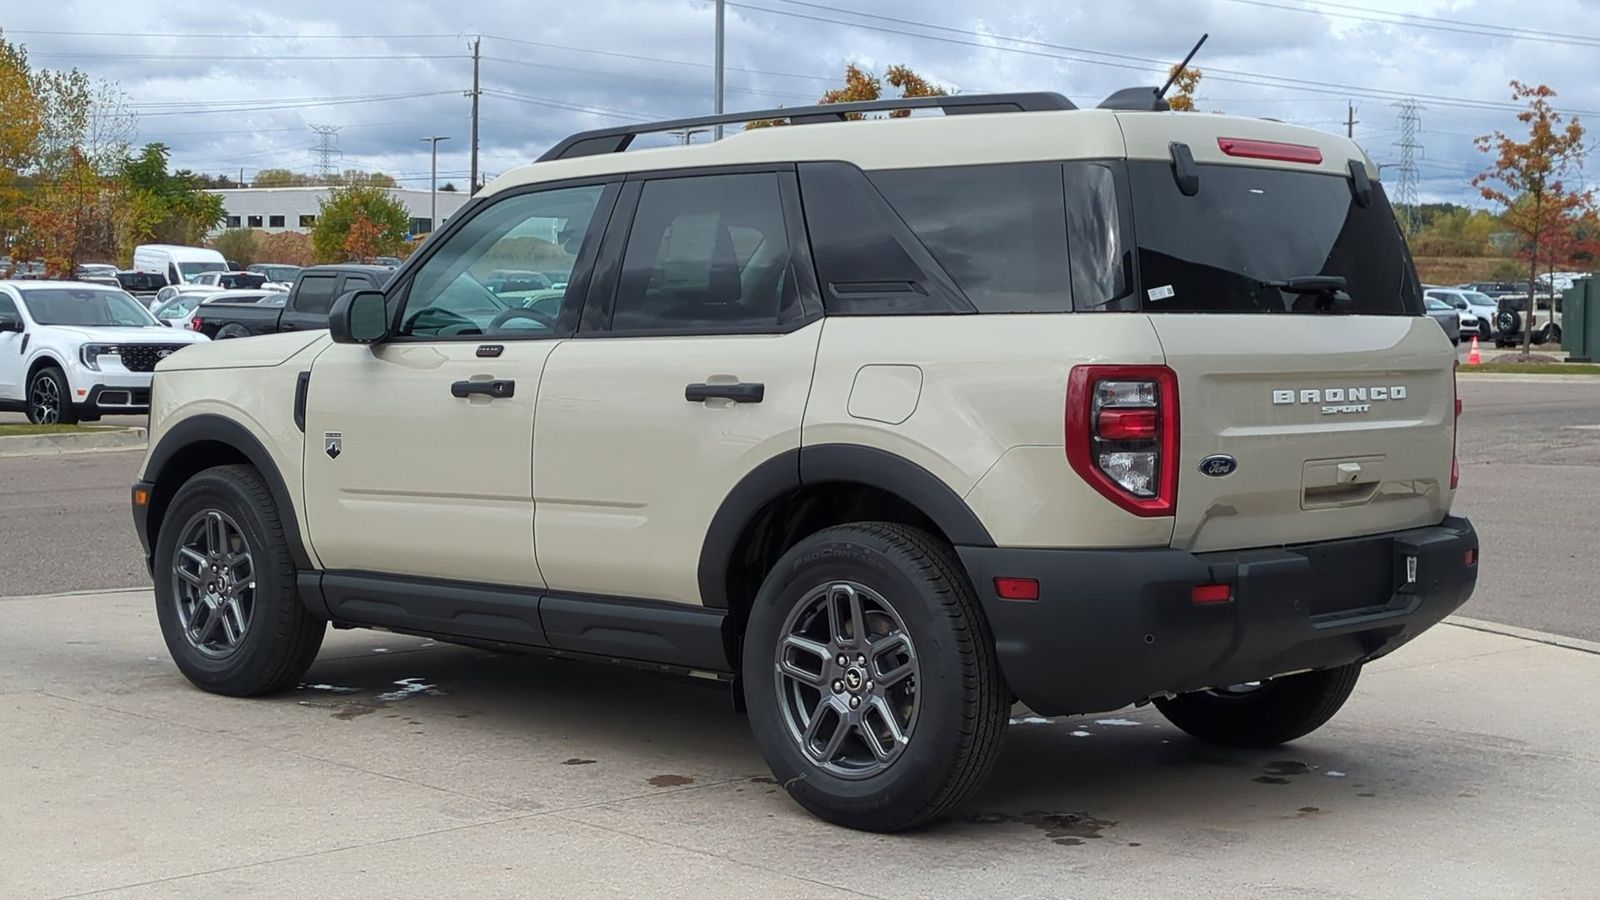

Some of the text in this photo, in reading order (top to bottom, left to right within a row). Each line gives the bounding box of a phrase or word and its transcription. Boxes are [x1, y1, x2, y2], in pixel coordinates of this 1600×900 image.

[1272, 386, 1407, 404] BRONCO
[1321, 404, 1371, 415] SPORT
[1208, 459, 1231, 474] Ford
